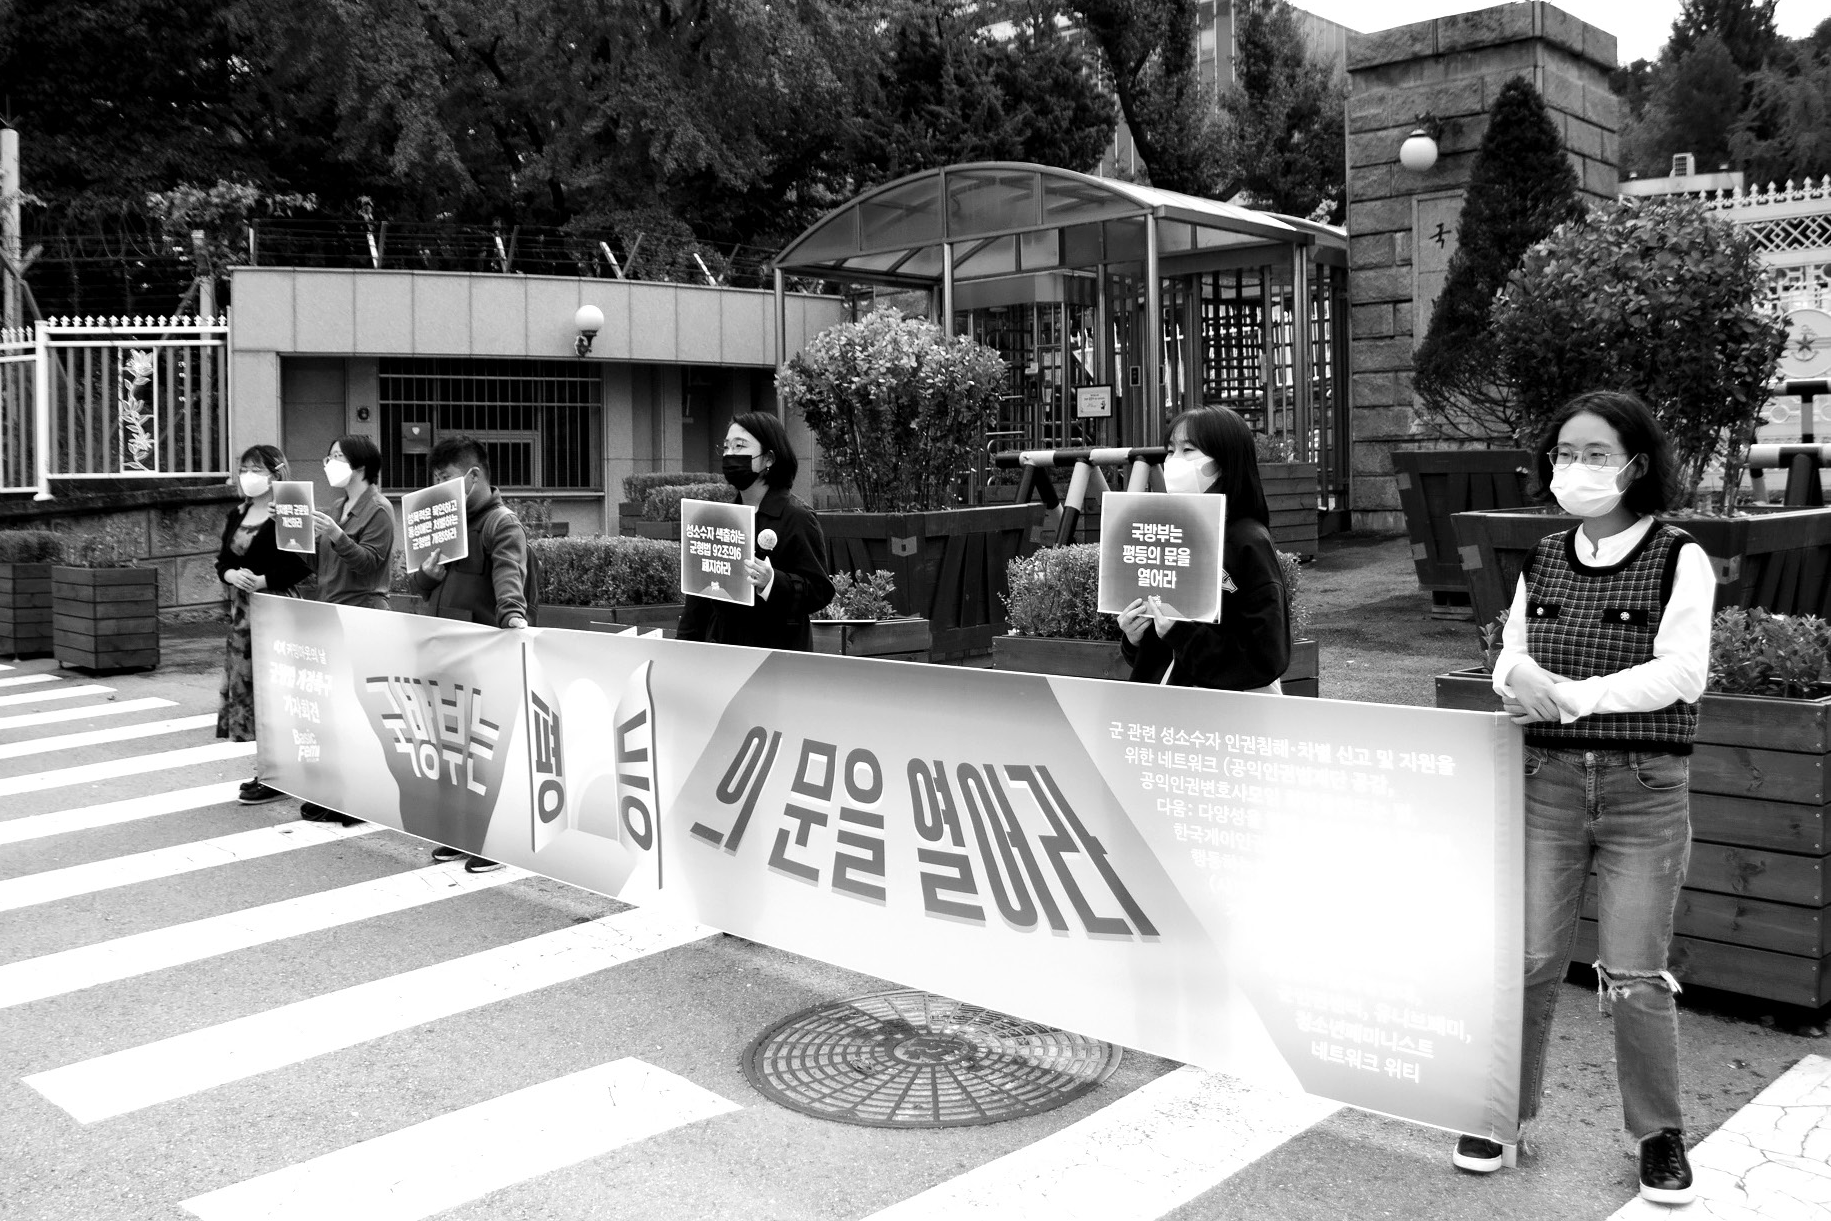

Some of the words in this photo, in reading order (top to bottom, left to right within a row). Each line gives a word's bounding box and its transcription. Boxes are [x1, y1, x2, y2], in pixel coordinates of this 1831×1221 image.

[407, 507, 432, 525] 성폭력은
[408, 521, 432, 538] 동성애만
[412, 535, 431, 550] 군형법
[432, 527, 457, 544] 개정하라
[686, 524, 714, 540] 성소수자
[716, 527, 745, 544] 색출하는
[1132, 523, 1183, 543] 국방부는
[690, 540, 711, 556] 군형법
[713, 544, 741, 560] 92조의6
[1123, 545, 1160, 565] 평등의
[1164, 547, 1191, 567] 문을
[702, 559, 731, 576] 폐지하라
[1138, 568, 1177, 589] 열어라
[1109, 721, 1124, 740] 군
[1127, 723, 1156, 744] 관련
[1160, 726, 1221, 751] 성소수자
[1399, 751, 1455, 776] 지원을
[1124, 746, 1154, 766] 위한
[1157, 750, 1217, 773] 네트워크
[366, 676, 499, 797] 국방부는
[767, 737, 887, 905] 문을
[906, 757, 1161, 939] 열어라
[1157, 798, 1193, 818] 다움:
[1311, 1041, 1380, 1073] 네트워크
[1384, 1057, 1420, 1084] 위티
